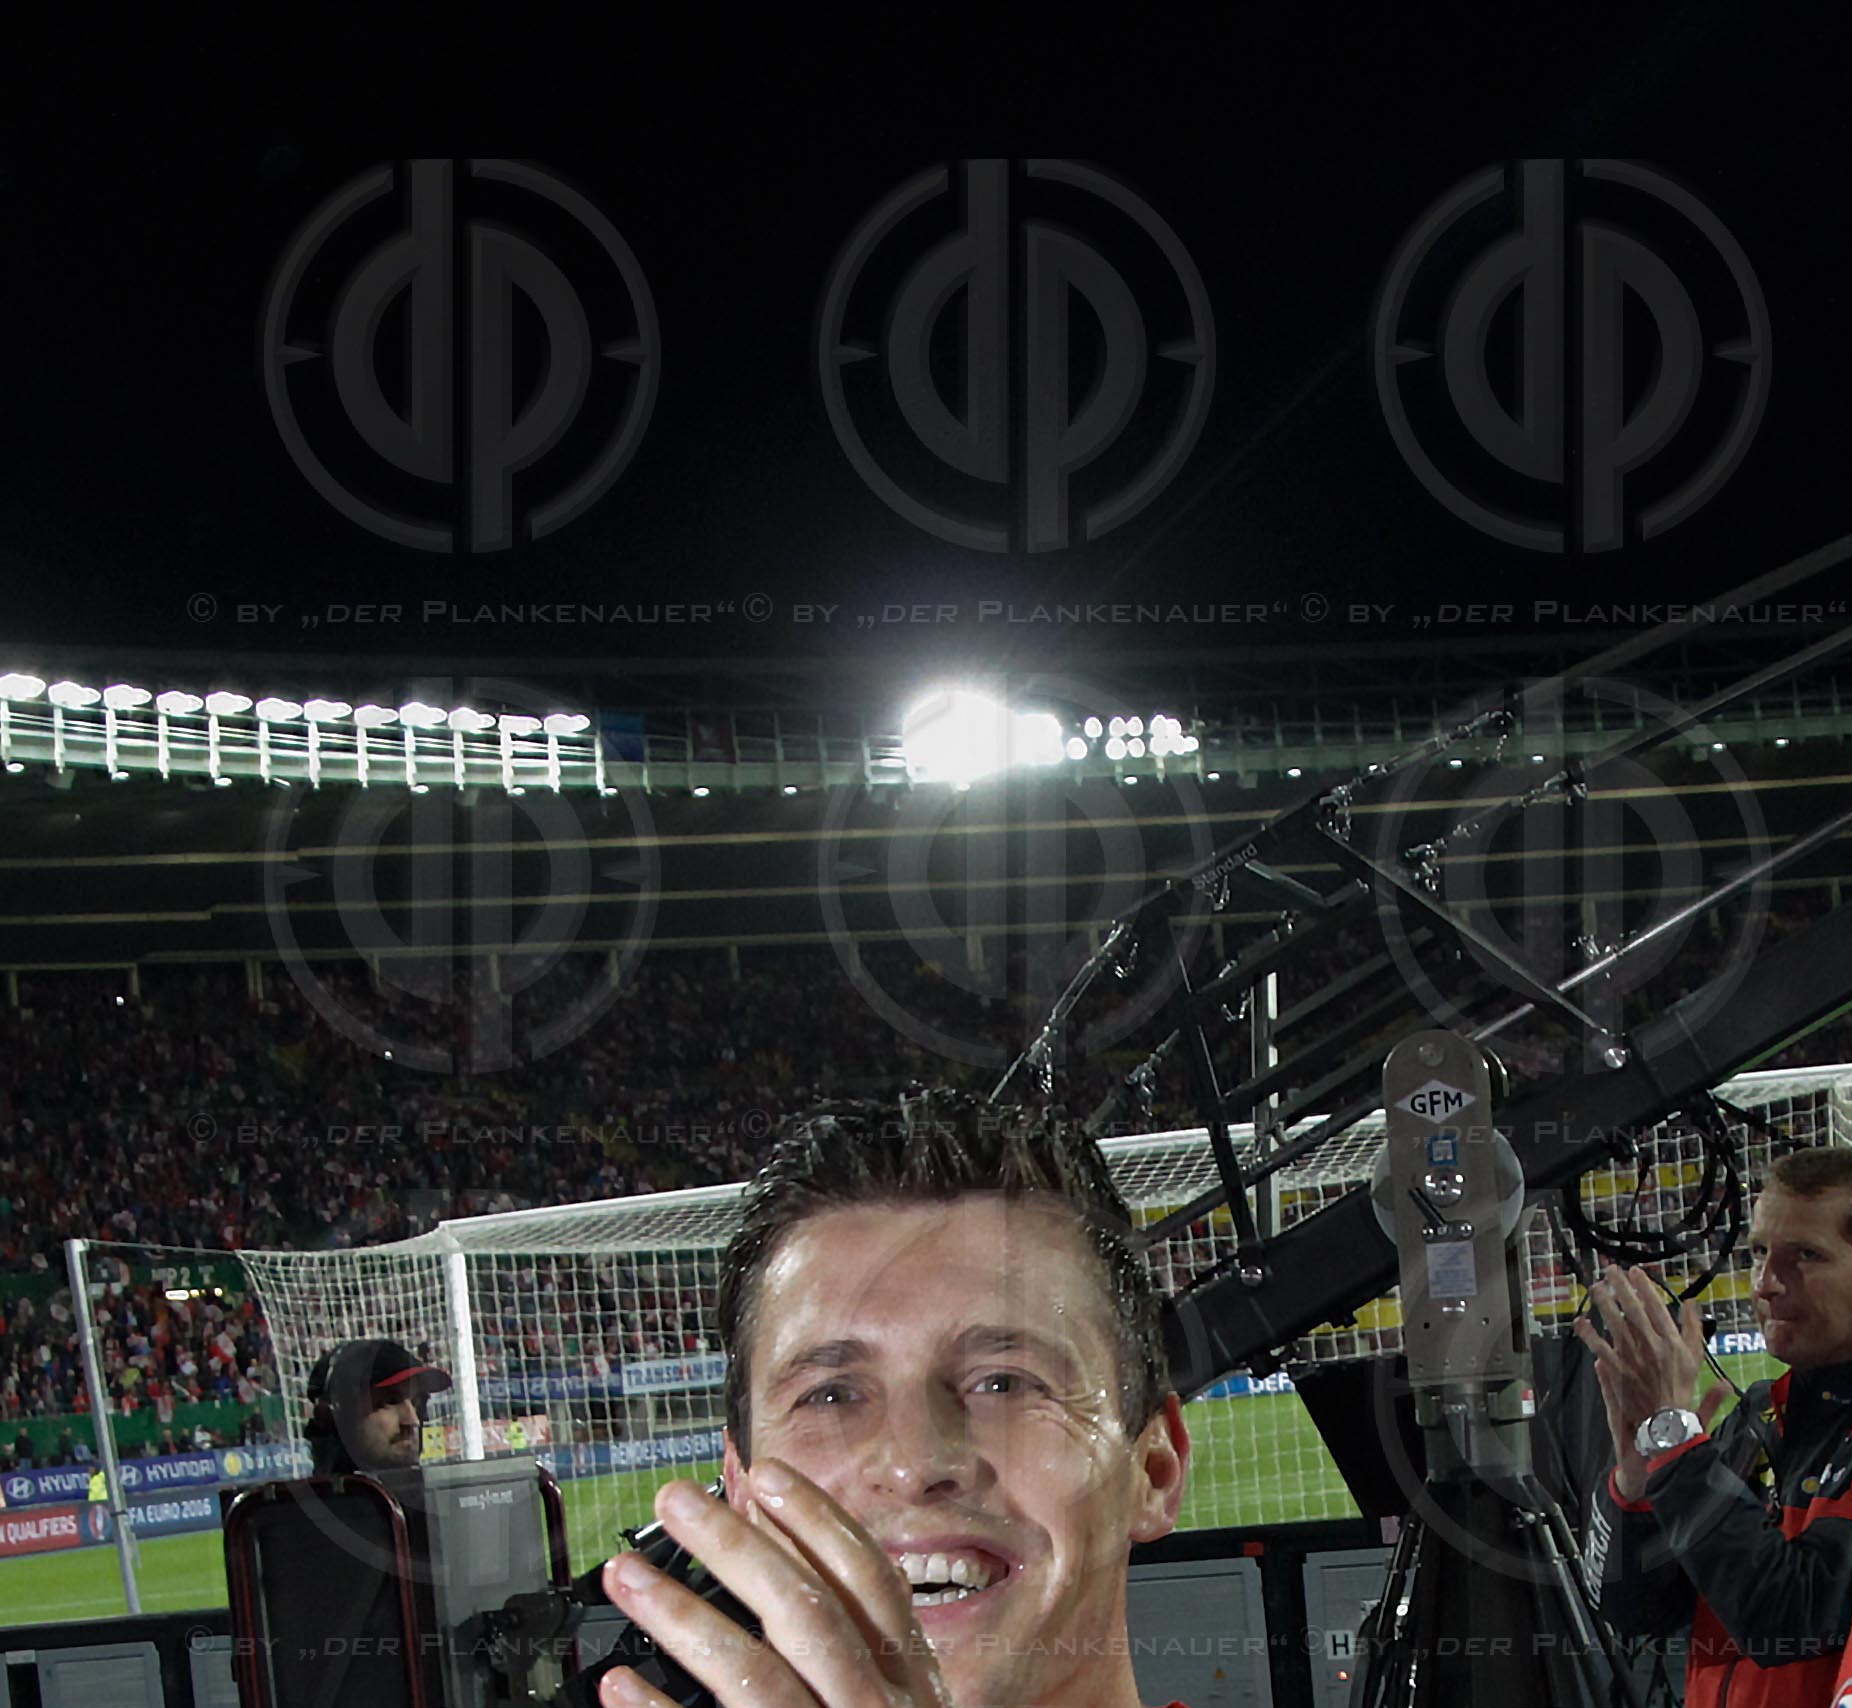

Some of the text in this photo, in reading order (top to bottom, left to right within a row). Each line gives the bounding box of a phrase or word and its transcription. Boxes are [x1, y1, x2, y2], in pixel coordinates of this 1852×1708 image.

[1409, 1090, 1463, 1117] GFM
[145, 1459, 216, 1482] HYUNDAI
[6, 1514, 77, 1544] QUALIFIERS
[1331, 1632, 1350, 1656] H
